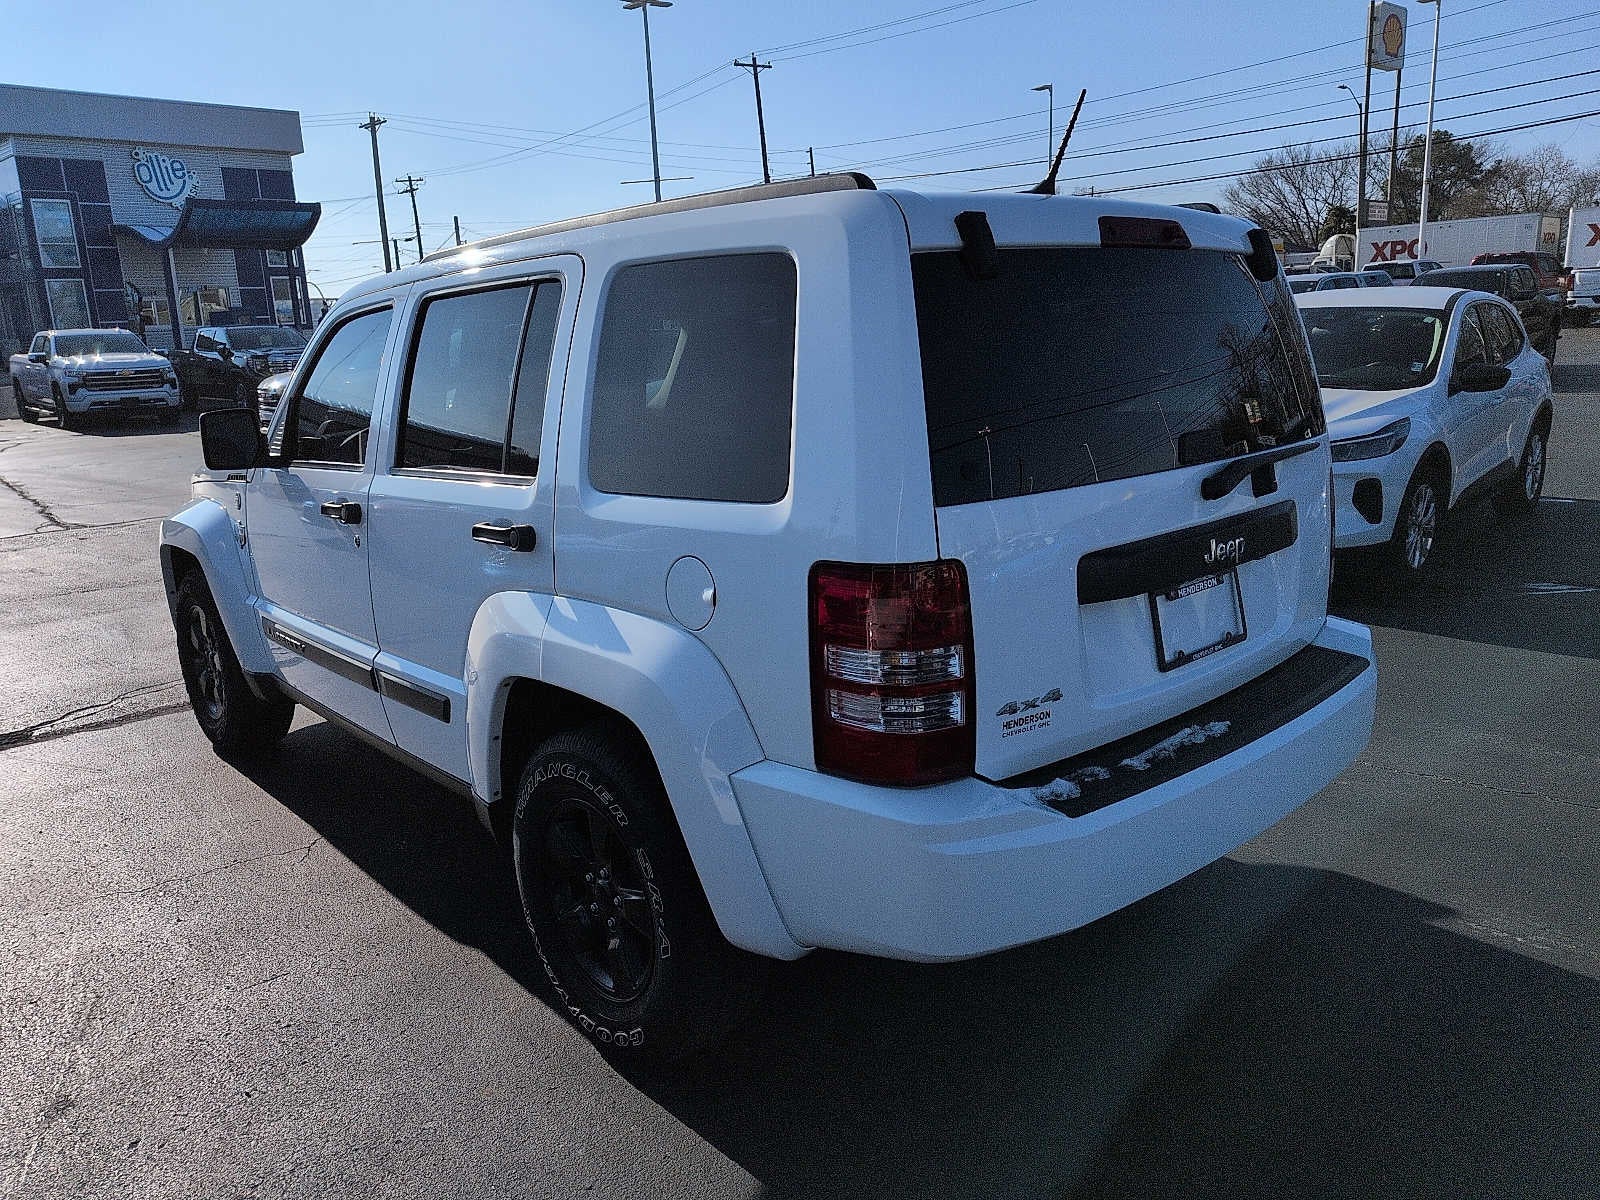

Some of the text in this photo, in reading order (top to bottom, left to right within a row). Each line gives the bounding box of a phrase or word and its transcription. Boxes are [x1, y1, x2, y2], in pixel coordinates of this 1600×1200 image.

[136, 154, 187, 192] ollie
[1370, 238, 1429, 263] XPO
[1203, 537, 1244, 564] Jeep
[1178, 577, 1218, 598] HENDERSON
[1001, 709, 1052, 731] HENDERSON
[1002, 720, 1052, 739] CHEVROLET GMC
[515, 762, 629, 828] WRANGLER
